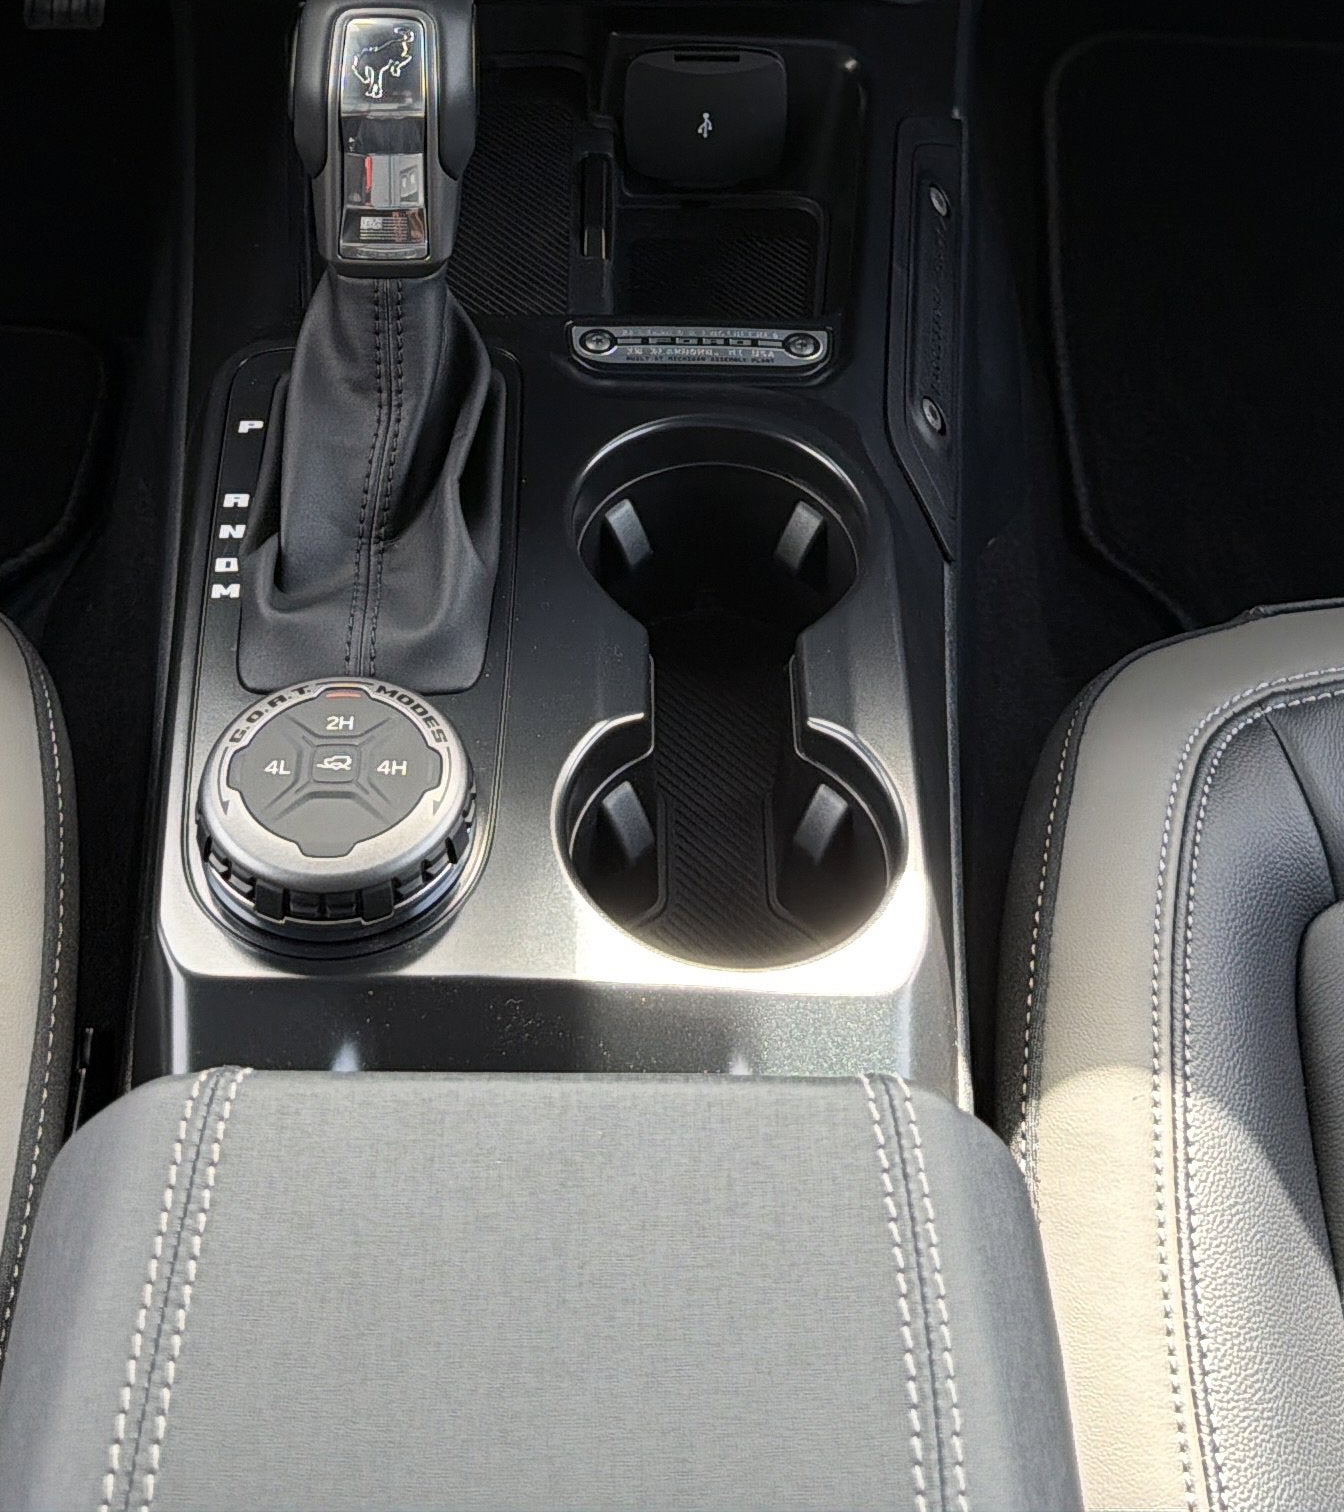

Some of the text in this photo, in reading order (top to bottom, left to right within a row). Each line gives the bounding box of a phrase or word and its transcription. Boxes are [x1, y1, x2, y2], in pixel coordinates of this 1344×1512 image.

[238, 420, 264, 434] P
[219, 524, 246, 539] N
[211, 583, 241, 599] M
[376, 685, 448, 744] MODES
[326, 716, 355, 731] 2H
[264, 760, 291, 775] 4L
[377, 760, 407, 775] 4H
